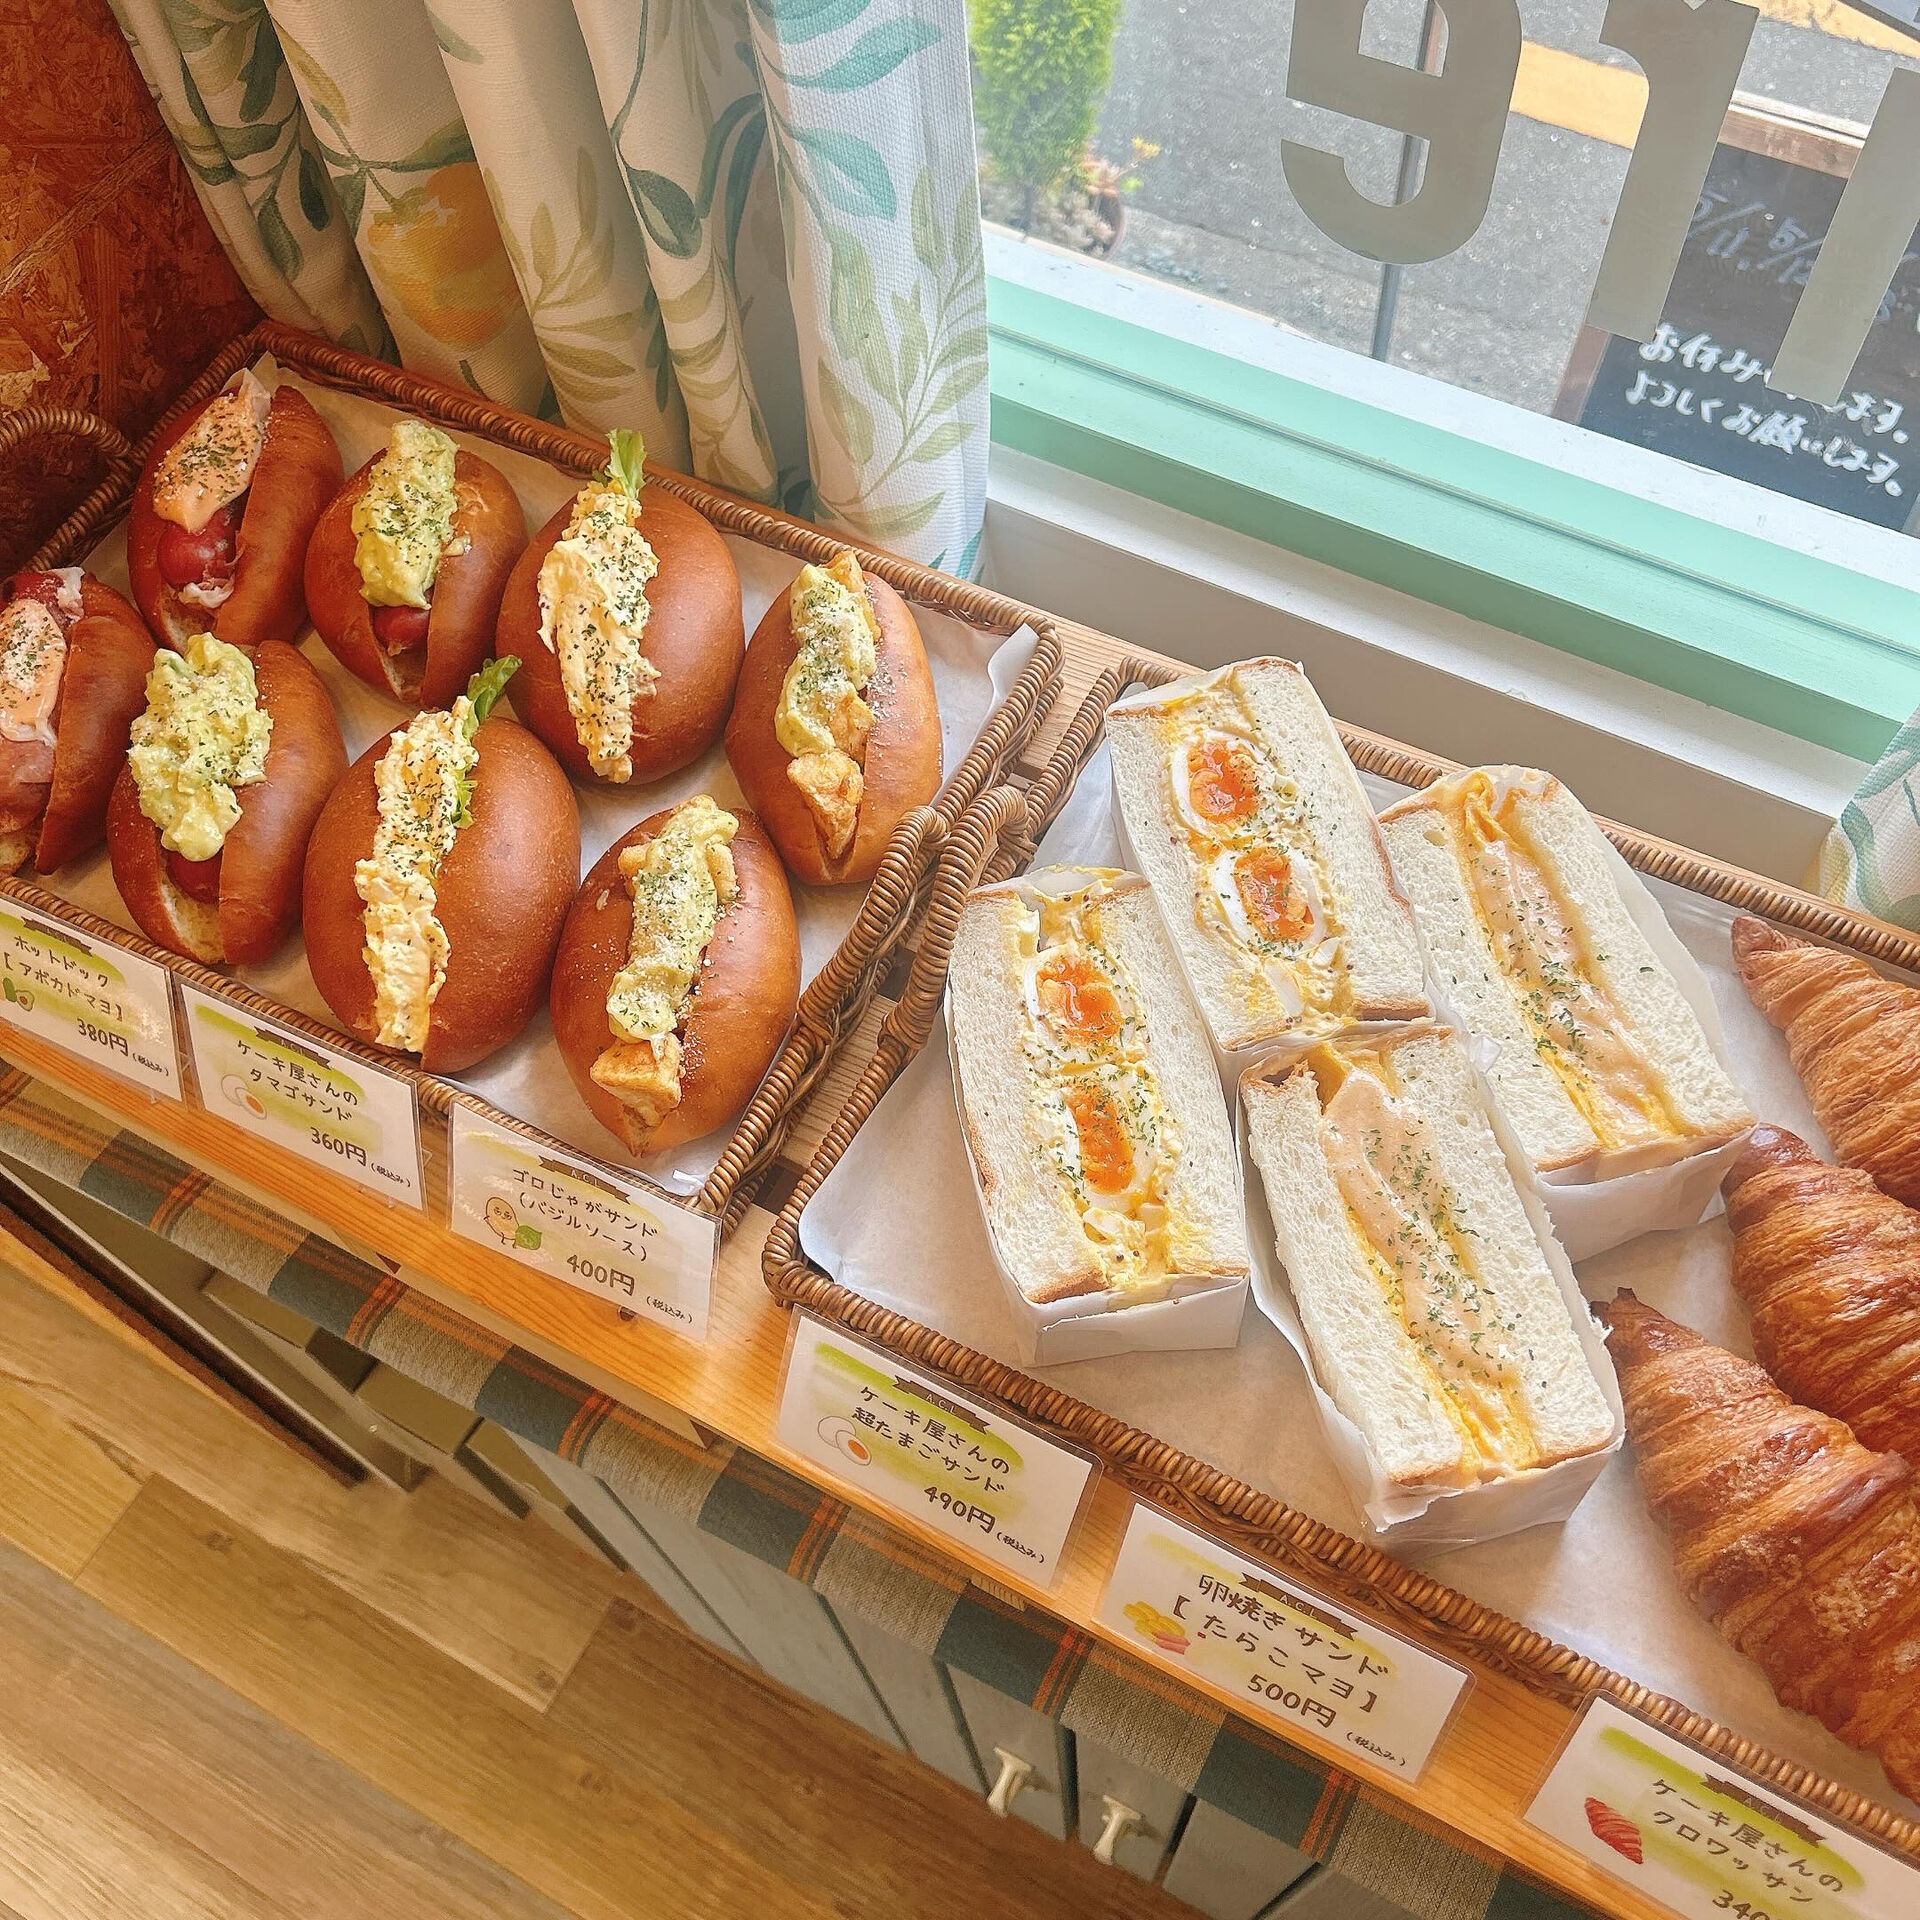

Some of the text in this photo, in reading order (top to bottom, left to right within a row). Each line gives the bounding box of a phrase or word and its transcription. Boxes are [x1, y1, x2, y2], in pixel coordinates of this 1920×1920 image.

[14, 935, 108, 988] ホットドック
[77, 1018, 129, 1057] 380円
[237, 1040, 358, 1106] ケーキ屋さんの
[250, 1068, 353, 1121] タマゴサンド
[309, 1126, 367, 1167] 360円
[512, 1168, 658, 1238] ゴロじゃがサンド
[519, 1192, 648, 1262] （バジルソース）
[566, 1254, 636, 1297] 400円
[852, 1406, 1005, 1494] 超たまごサンド
[860, 1386, 1010, 1475] ケーキ屋さんの
[923, 1486, 996, 1533] 490円
[1198, 1574, 1390, 1677] 卵焼きサンド
[1247, 1673, 1337, 1728] 500円
[1652, 1778, 1844, 1893] ケーキ屋さんの
[1653, 1809, 1813, 1904] クロワッサン
